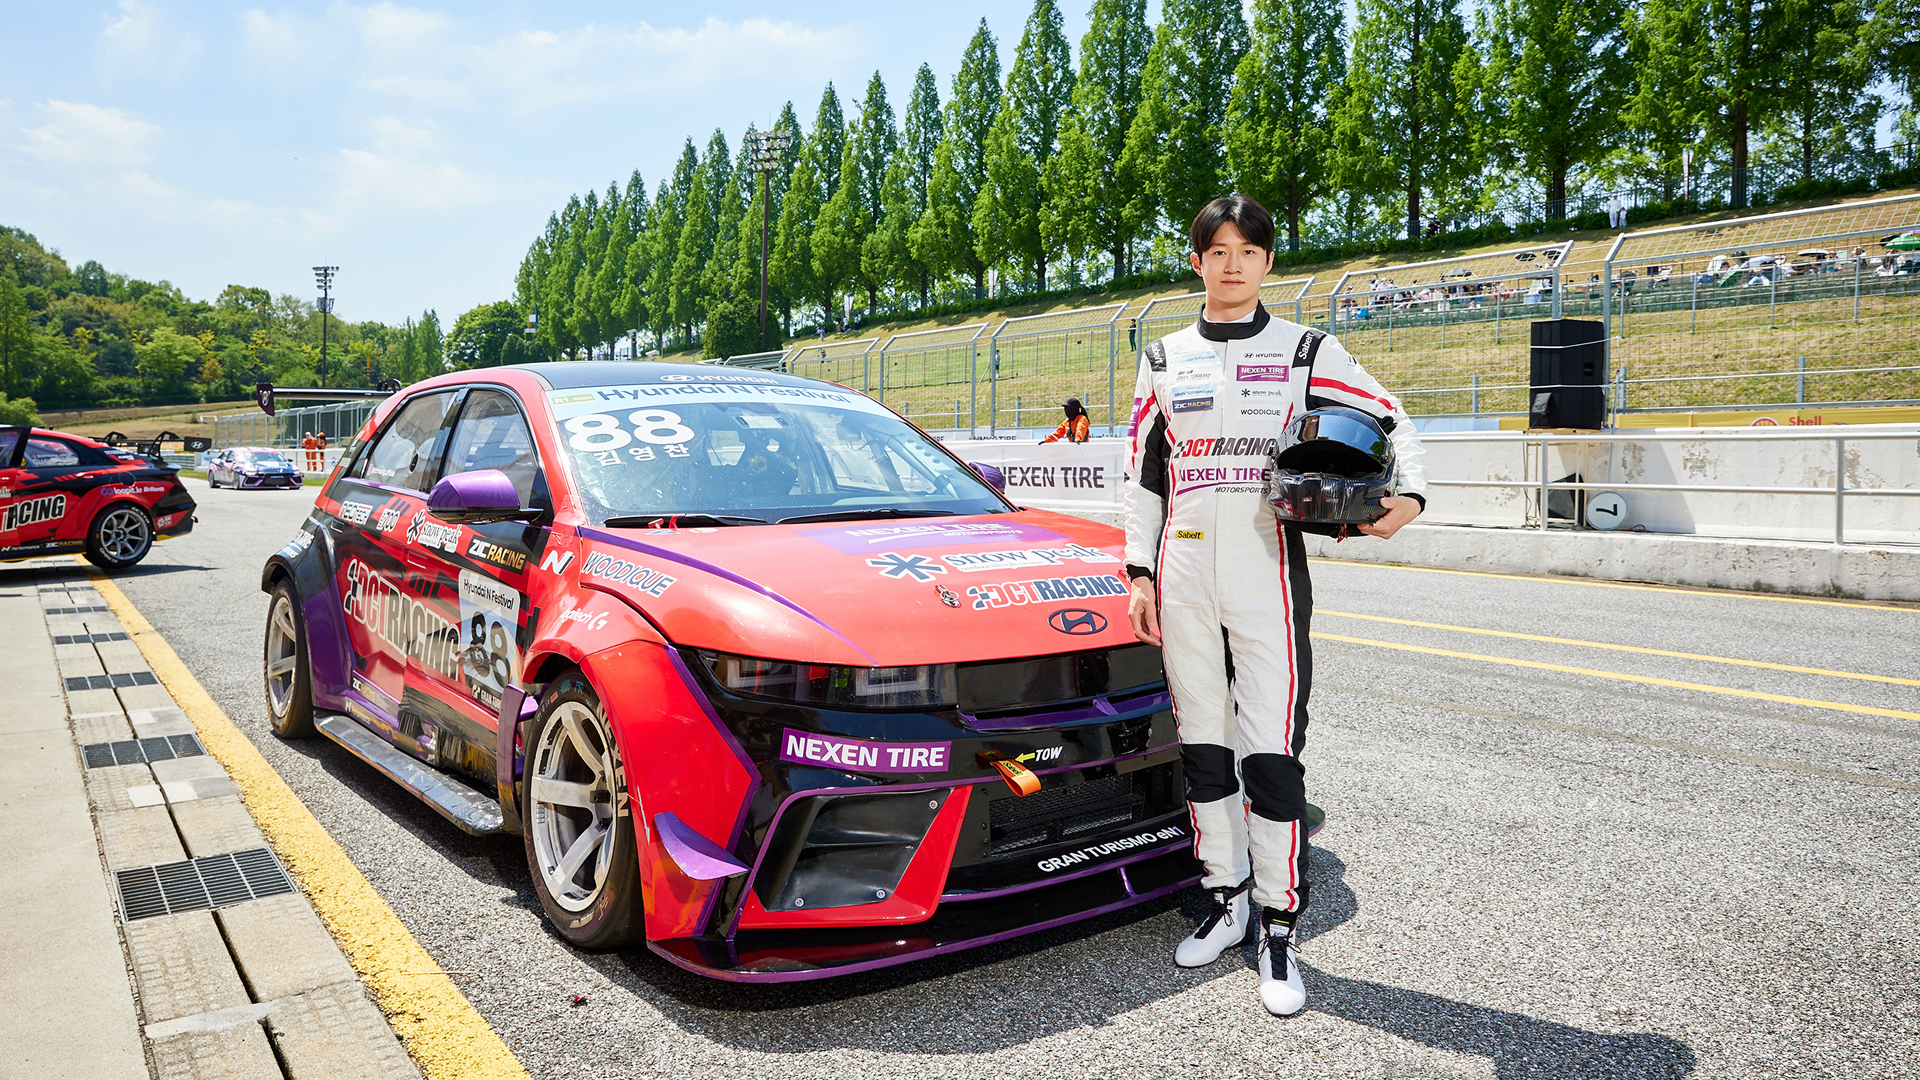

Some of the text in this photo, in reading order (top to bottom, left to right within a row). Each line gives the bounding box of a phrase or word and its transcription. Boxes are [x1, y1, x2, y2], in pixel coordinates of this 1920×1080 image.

[1298, 332, 1314, 360] Sabelt
[696, 375, 779, 385] HYUNDAI
[597, 382, 724, 401] Hyundai
[726, 385, 753, 394] N
[752, 386, 852, 404] Festival
[565, 409, 695, 452] 88
[1788, 415, 1822, 427] Shell
[594, 443, 691, 467] 김영찬
[1060, 466, 1105, 489] TIRE
[1178, 467, 1271, 482] NEXEN TIRE
[1215, 486, 1268, 494] MOTORSPORTS
[1595, 503, 1618, 516] 7
[845, 523, 1011, 537] NEXEN TIRE
[1178, 530, 1200, 539] Sabelt
[469, 539, 490, 559] ZIC
[487, 544, 526, 570] RACING
[945, 544, 1107, 566] snow peak
[582, 551, 676, 597] WOODIQUE
[463, 579, 486, 598] Hyundai
[491, 590, 515, 610] Festival
[978, 576, 1127, 606] DCTRACING
[471, 611, 511, 690] 88
[786, 734, 945, 768] NEXEN TIRE
[1036, 746, 1063, 761] TOW
[1037, 825, 1186, 872] GRAN TURISMO eN1
